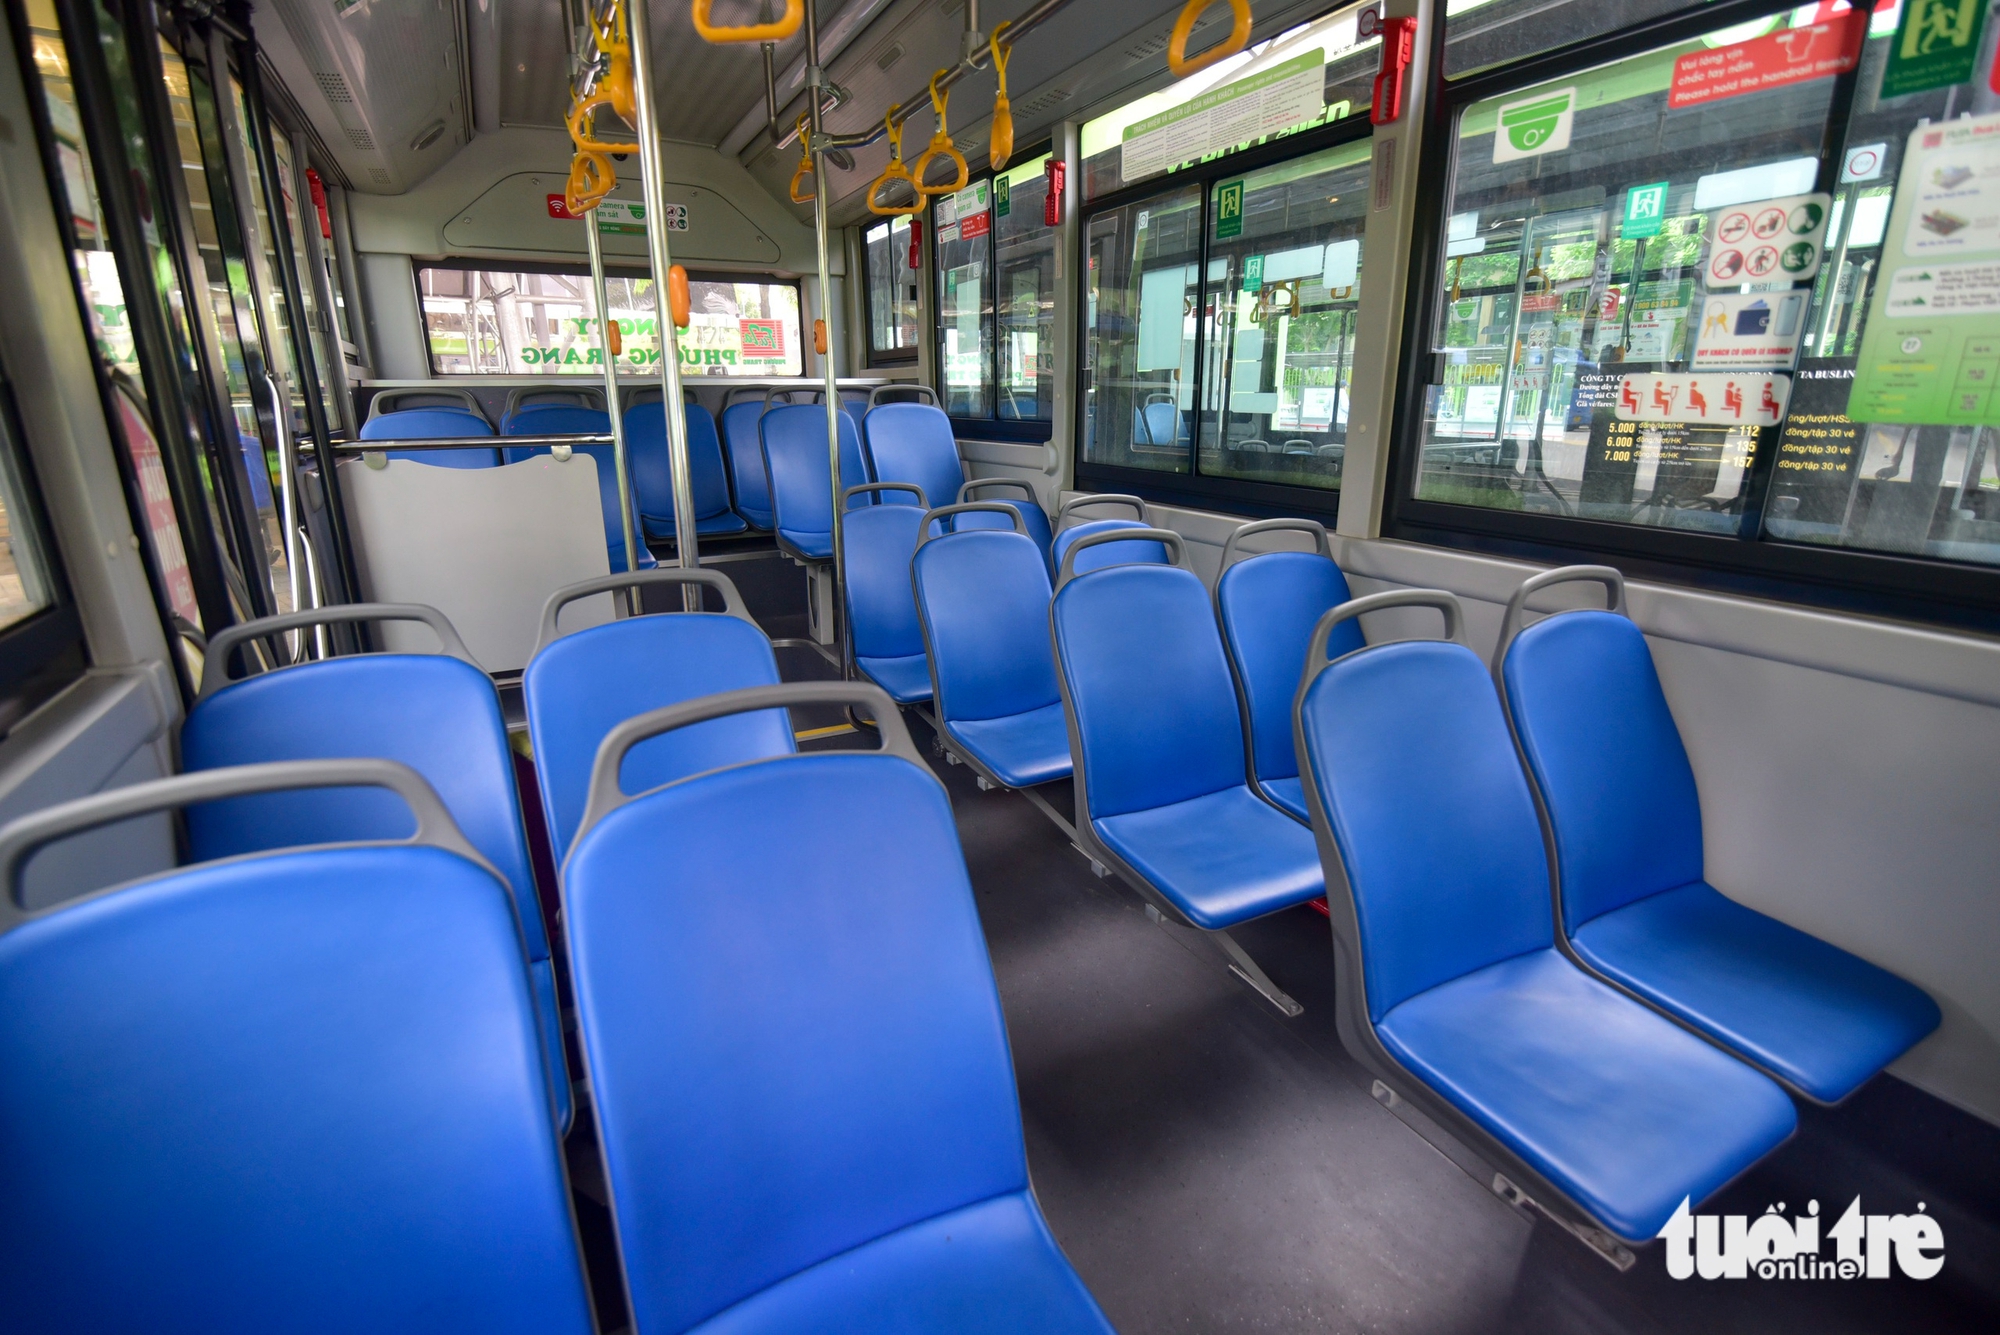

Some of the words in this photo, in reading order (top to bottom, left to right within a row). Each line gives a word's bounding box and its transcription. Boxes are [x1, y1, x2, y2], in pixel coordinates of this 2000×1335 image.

[1707, 67, 1725, 80] tay
[1675, 87, 1710, 102] Please
[1712, 82, 1737, 94] hold
[1740, 76, 1759, 88] the
[1761, 64, 1813, 83] handrail
[1217, 87, 1235, 100] KHÁCH
[607, 210, 619, 219] sát
[1580, 374, 1604, 382] CÔNG
[1814, 369, 1856, 379] BUSLIN
[1608, 422, 1635, 434] 5.000
[1738, 425, 1760, 437] 112
[1785, 427, 1827, 438] đồng/tập
[1828, 428, 1841, 438] 30
[1843, 429, 1856, 438] vé
[1606, 436, 1633, 448] 6.000
[1736, 440, 1757, 452] 135
[1781, 443, 1823, 454] đồng/tập
[1825, 445, 1838, 454] 30
[1839, 445, 1851, 455] vé
[1604, 450, 1631, 462] 7.000
[1732, 456, 1754, 468] 157
[1778, 459, 1819, 470] đồng/tập
[1821, 461, 1834, 471] 30
[1835, 462, 1847, 471] vé
